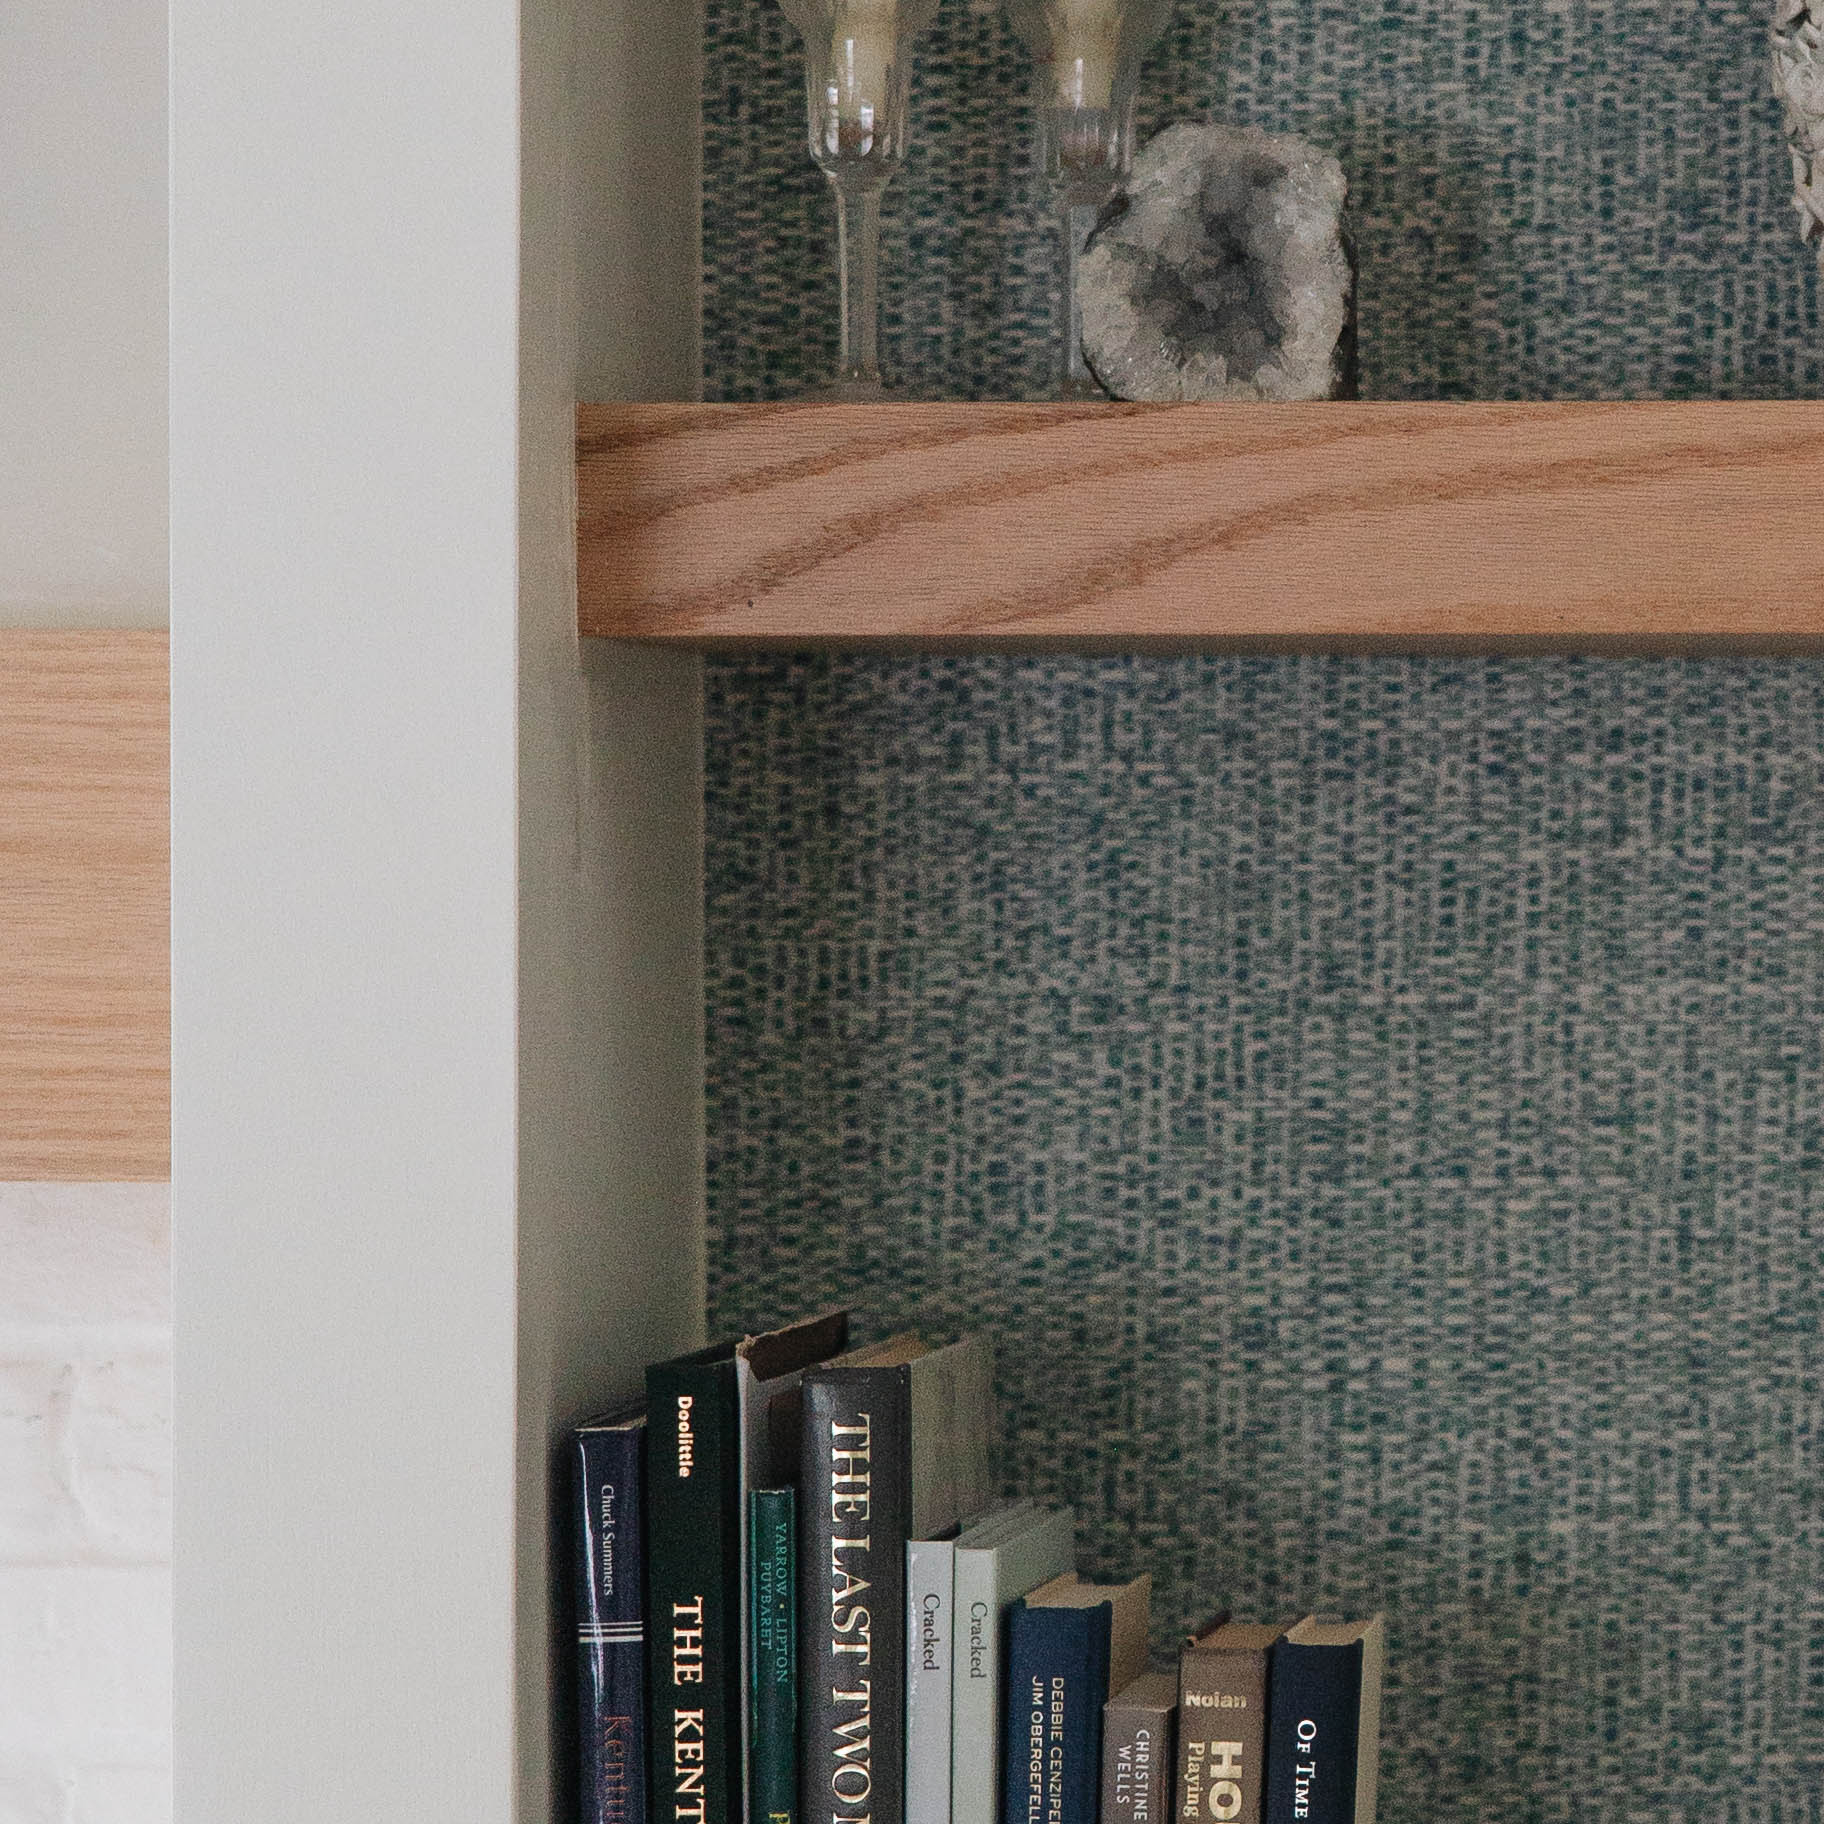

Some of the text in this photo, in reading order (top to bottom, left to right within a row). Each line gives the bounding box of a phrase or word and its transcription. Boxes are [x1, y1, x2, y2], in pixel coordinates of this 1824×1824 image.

[677, 1395, 694, 1479] Doolittle
[831, 1413, 871, 1522] THE
[600, 1484, 615, 1596] Chuck Summers
[672, 1595, 704, 1686] THE
[759, 1560, 772, 1650] PUYBARET
[775, 1522, 788, 1683] YARROW LIPTON
[831, 1533, 871, 1666] LAST
[922, 1593, 940, 1671] Cracked
[969, 1602, 987, 1679] Cracked
[1032, 1676, 1043, 1706] JIM
[1050, 1677, 1064, 1740] DEBBIE
[1185, 1690, 1247, 1708] Nolan
[831, 1680, 871, 1804] TWO
[1116, 1744, 1131, 1804] WELLS
[1133, 1729, 1150, 1822] CHRISTINE
[1183, 1742, 1205, 1817] Playing
